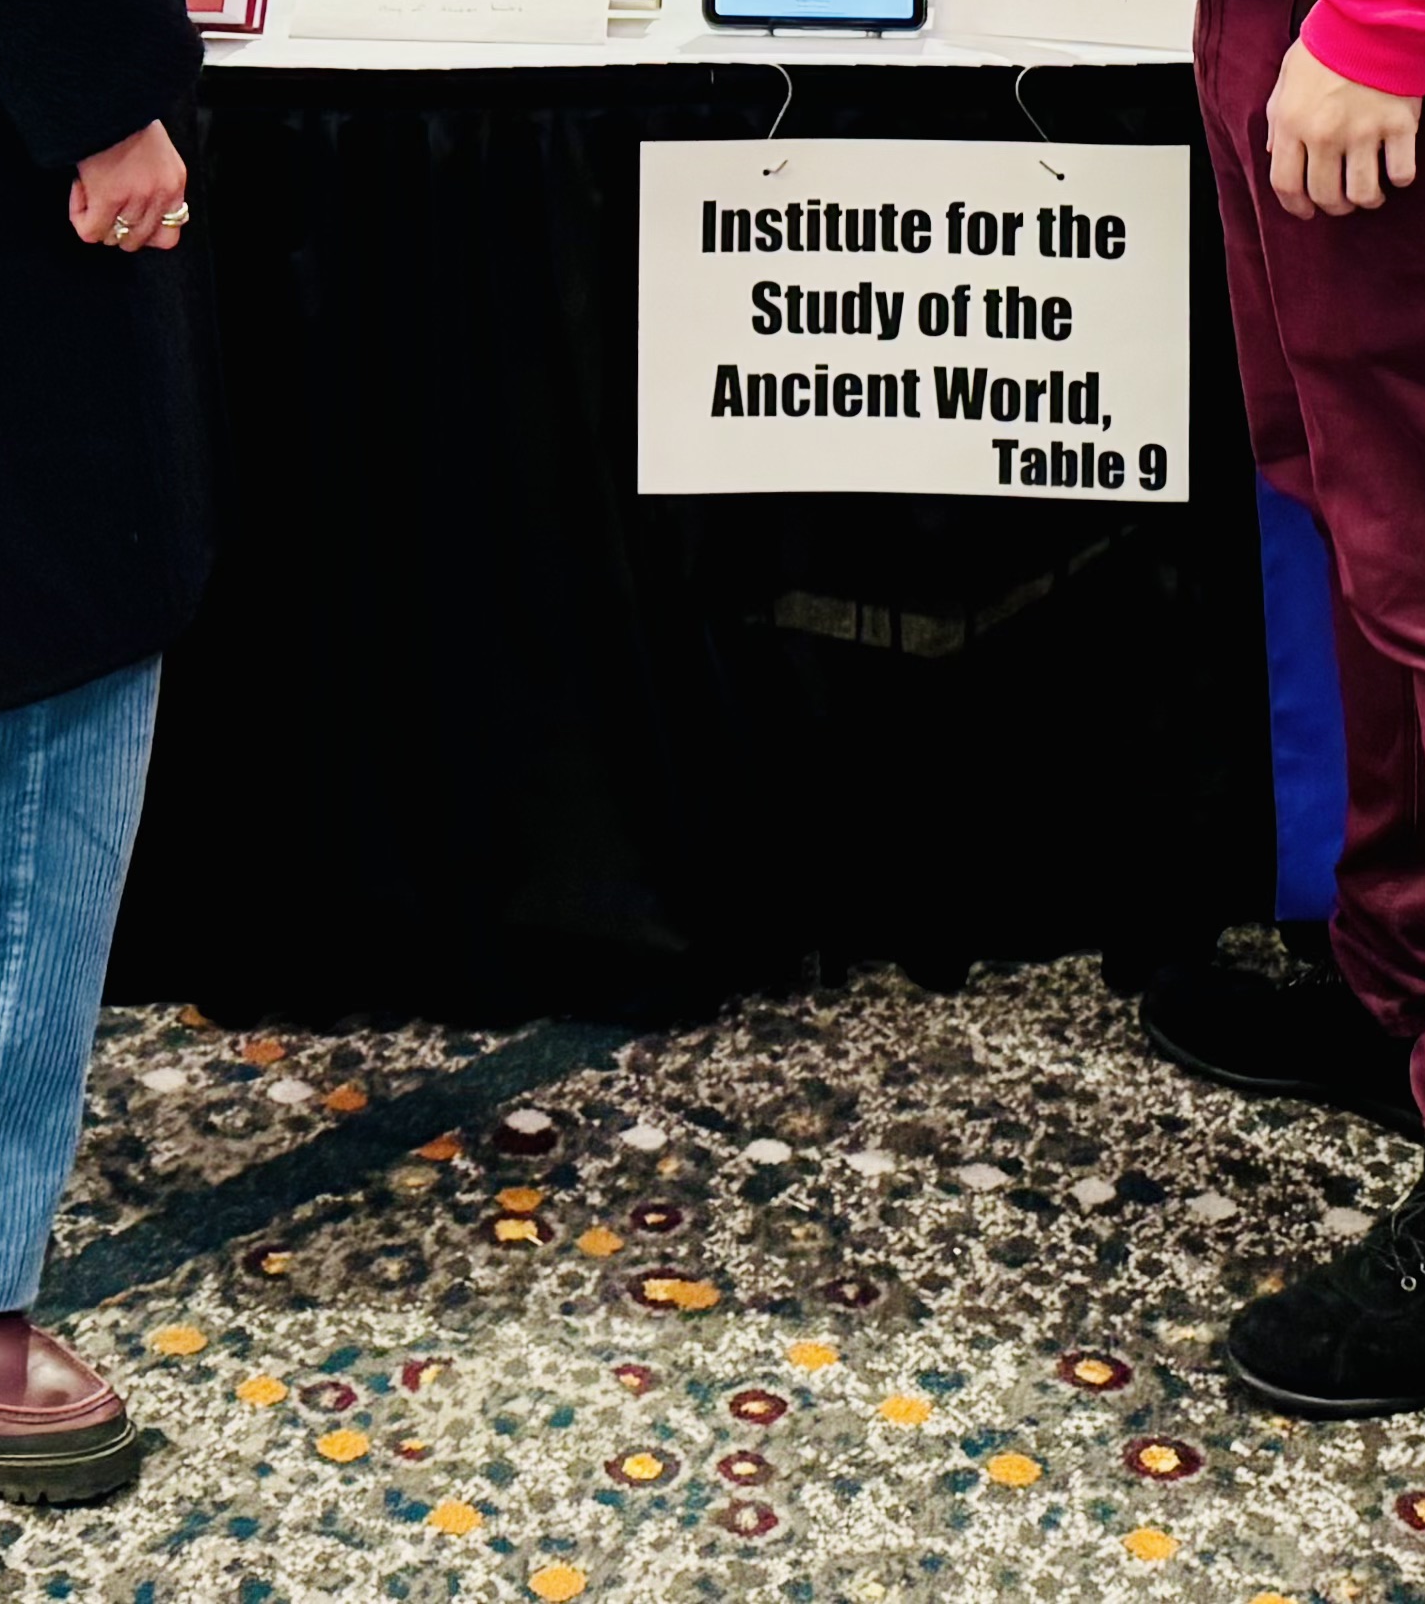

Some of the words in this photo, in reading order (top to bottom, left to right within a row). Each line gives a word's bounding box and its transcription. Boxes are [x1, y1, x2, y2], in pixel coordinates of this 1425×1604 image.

[701, 199, 932, 254] Institute
[945, 201, 1024, 256] for
[1037, 204, 1127, 260] the
[751, 280, 905, 341] Study
[918, 284, 971, 337] of
[984, 286, 1073, 341] the
[711, 363, 921, 418] Ancient
[933, 365, 1112, 432] World,
[992, 438, 1125, 489] Table
[1138, 443, 1168, 491] 9
